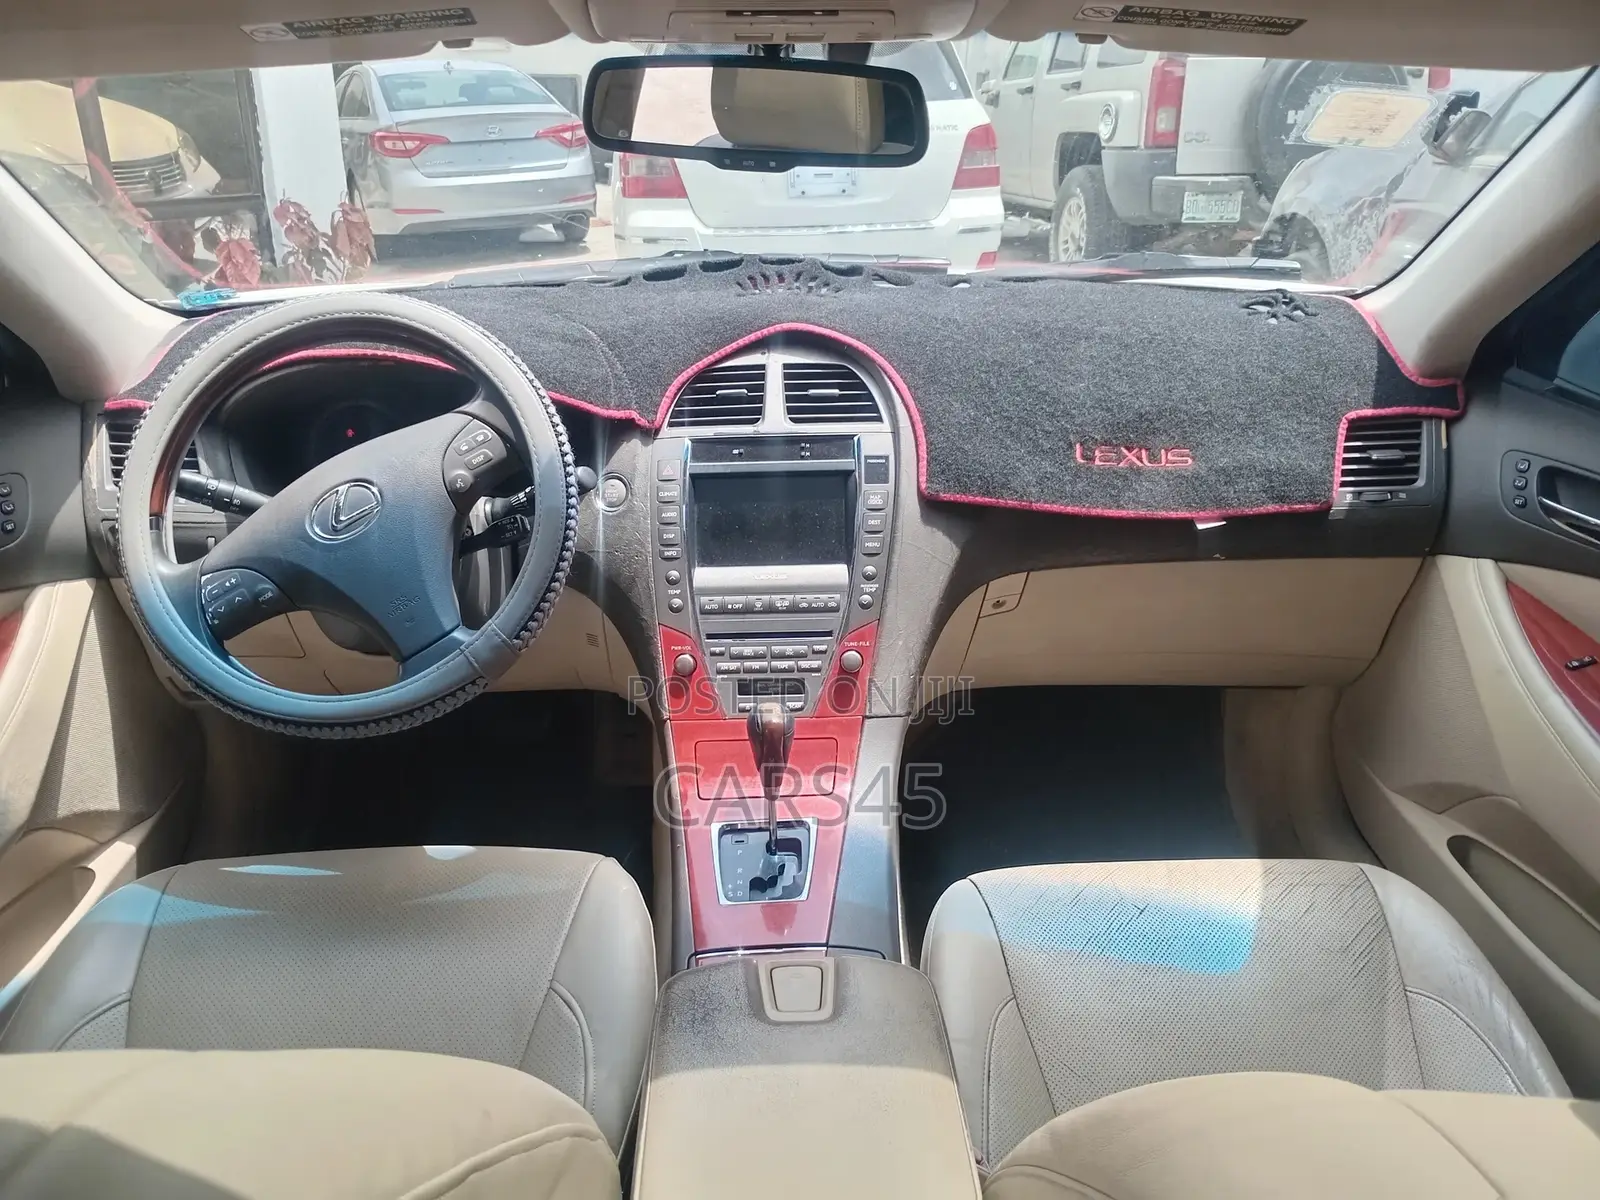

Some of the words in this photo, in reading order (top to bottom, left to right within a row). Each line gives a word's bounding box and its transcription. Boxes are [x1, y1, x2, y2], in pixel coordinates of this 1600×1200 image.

[293, 15, 365, 28] AIRBAG
[374, 8, 465, 22] WARNING
[1128, 6, 1200, 17] AIRBAG
[1210, 12, 1299, 25] WARNING
[1075, 442, 1193, 468] LEXUS
